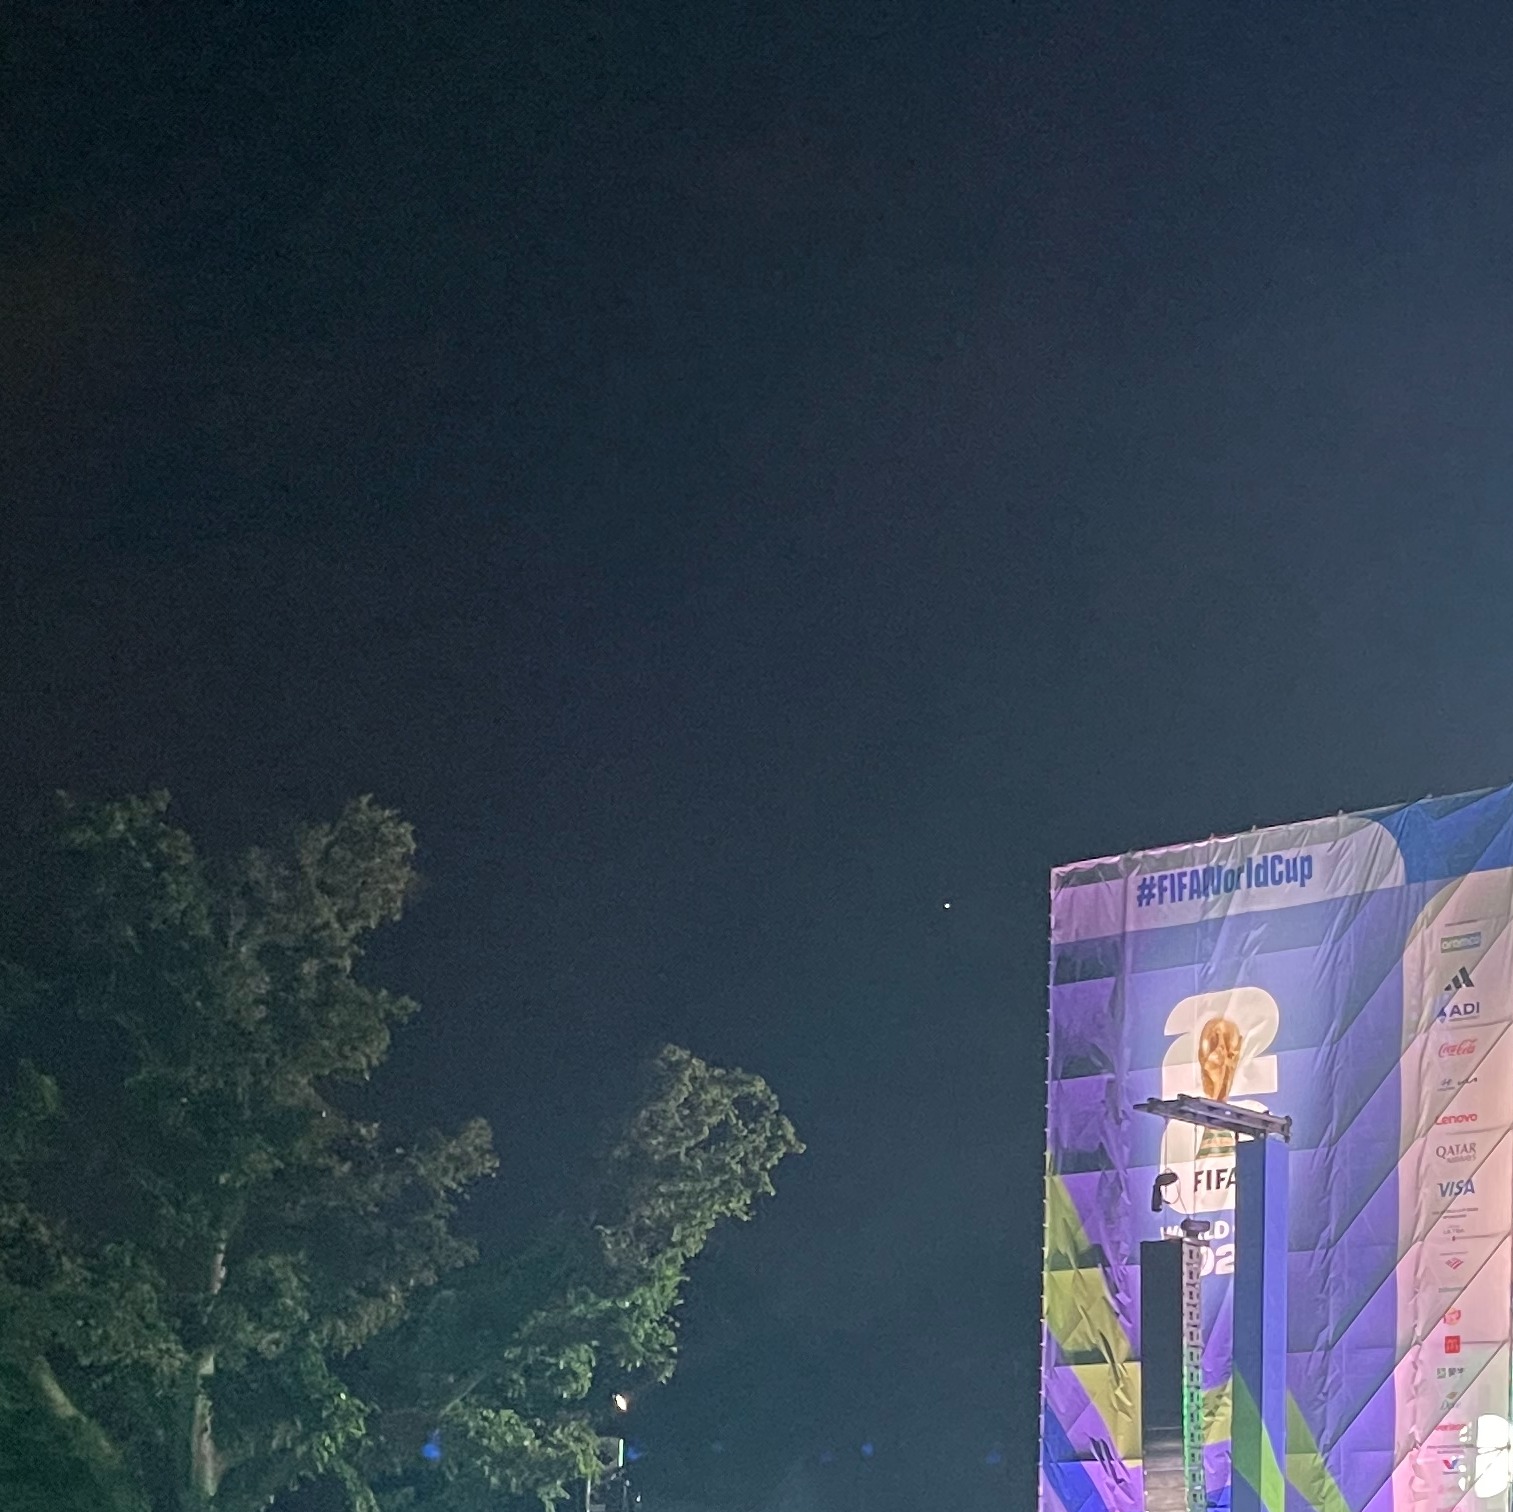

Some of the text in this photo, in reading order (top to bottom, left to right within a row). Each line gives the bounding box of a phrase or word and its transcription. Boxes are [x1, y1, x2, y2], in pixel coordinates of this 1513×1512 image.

[1137, 854, 1313, 907] #FIFAWorldCup
[1449, 1001, 1481, 1017] ADI
[1434, 1112, 1478, 1126] Lenovo
[1435, 1142, 1477, 1160] QATAR
[1437, 1178, 1476, 1198] VISA
